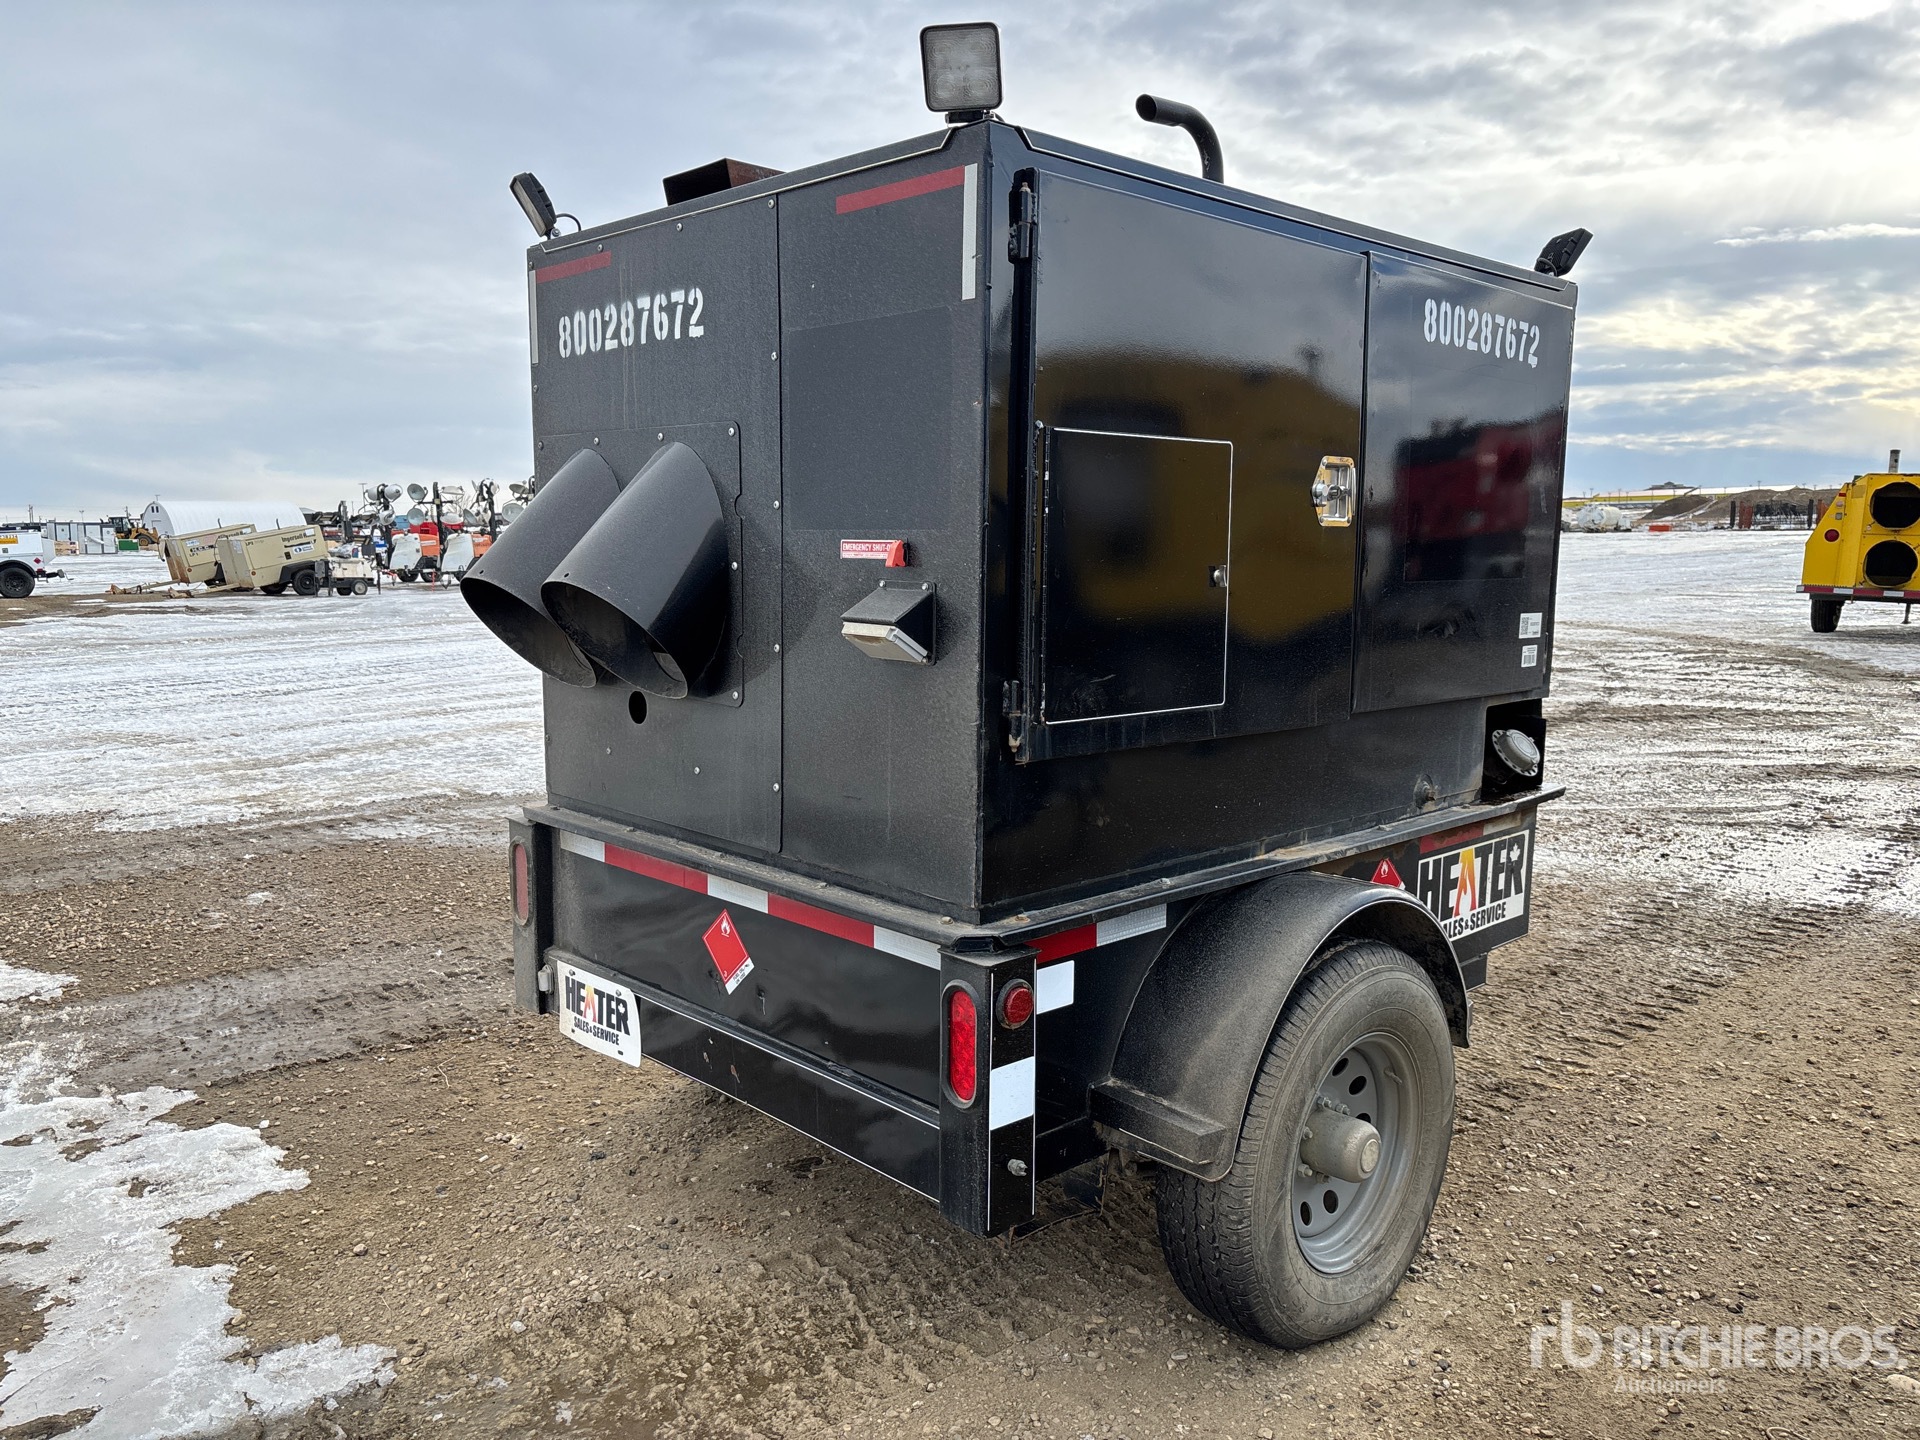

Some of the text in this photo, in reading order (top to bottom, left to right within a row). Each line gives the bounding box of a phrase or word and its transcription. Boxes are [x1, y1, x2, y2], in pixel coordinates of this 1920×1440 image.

[558, 287, 704, 358] 800287672
[1423, 298, 1540, 368] 800287672
[843, 543, 891, 551] EMERGENCY SHUT-O
[1418, 834, 1526, 922] HEATER
[564, 975, 631, 1036] HEATER
